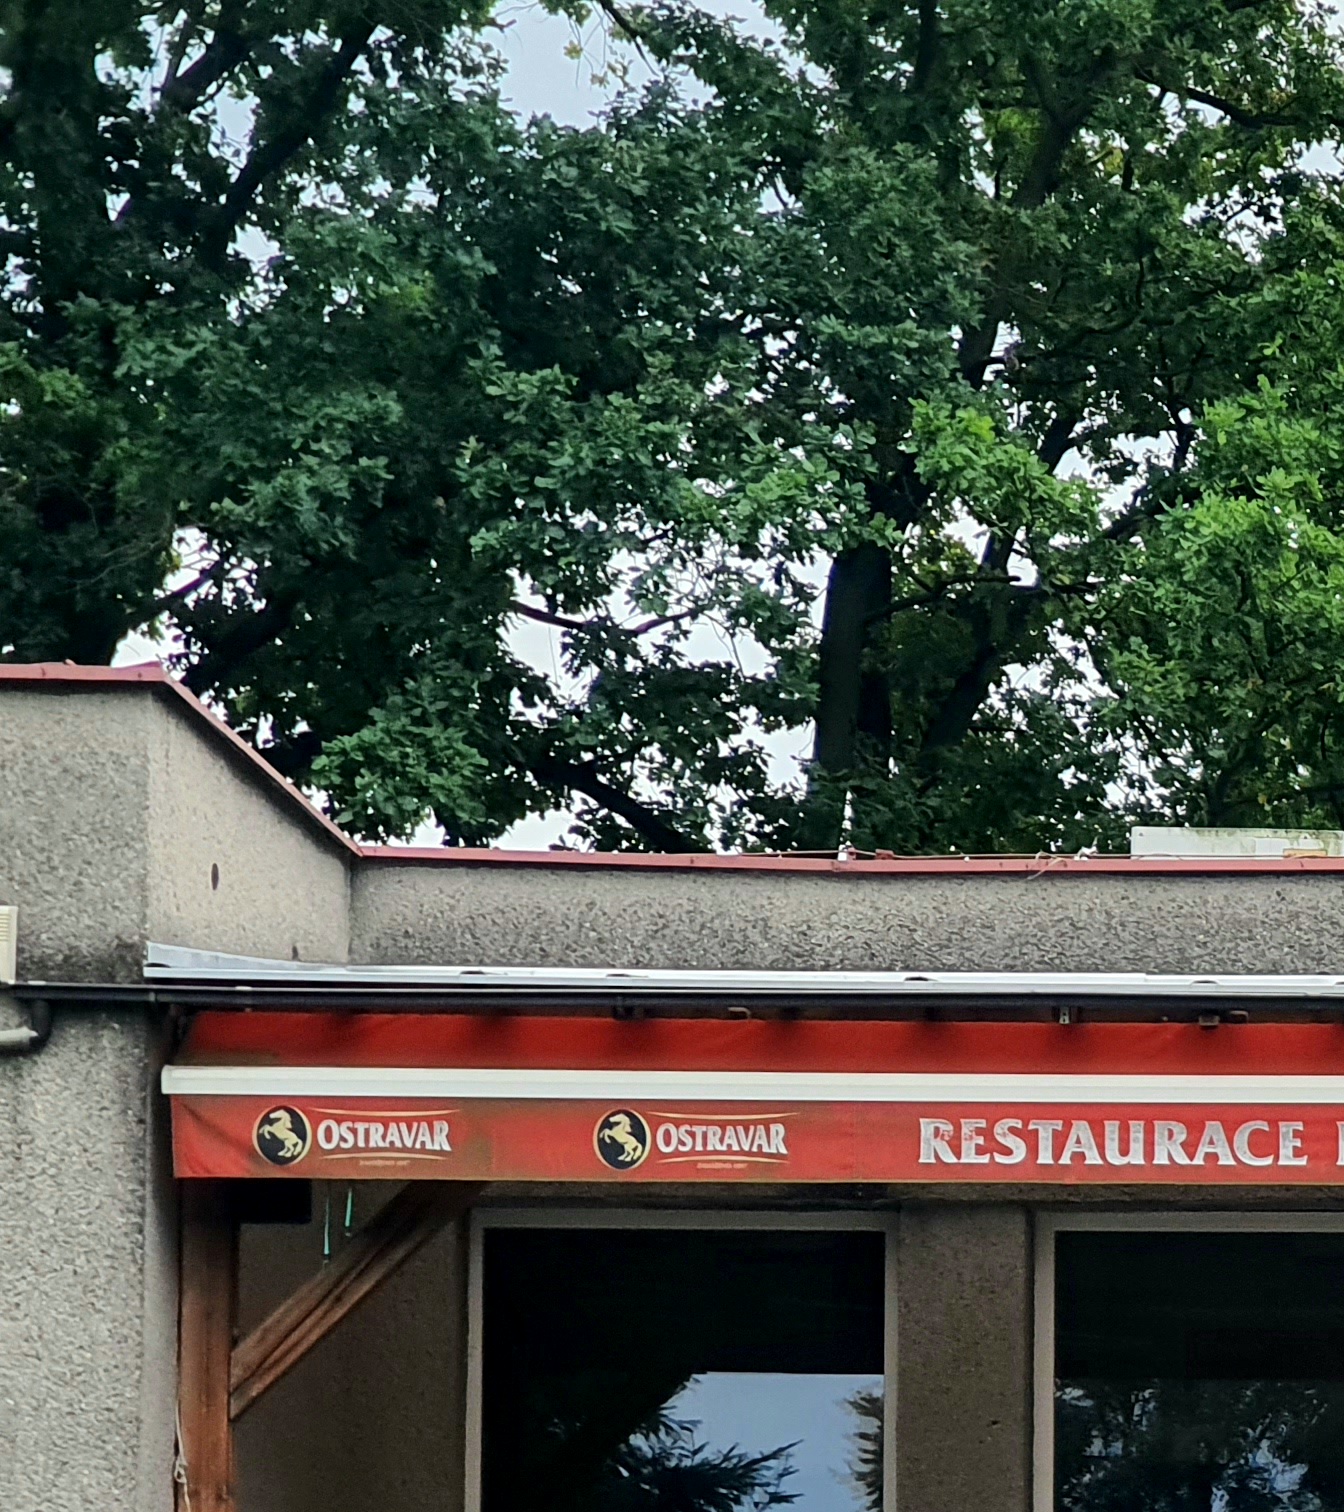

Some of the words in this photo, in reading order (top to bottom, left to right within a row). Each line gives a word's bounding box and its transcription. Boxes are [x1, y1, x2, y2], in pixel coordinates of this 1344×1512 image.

[317, 1119, 452, 1151] OSTRAVAR
[656, 1122, 788, 1154] OSTRAVAR
[917, 1116, 1308, 1166] RESTAURACE
